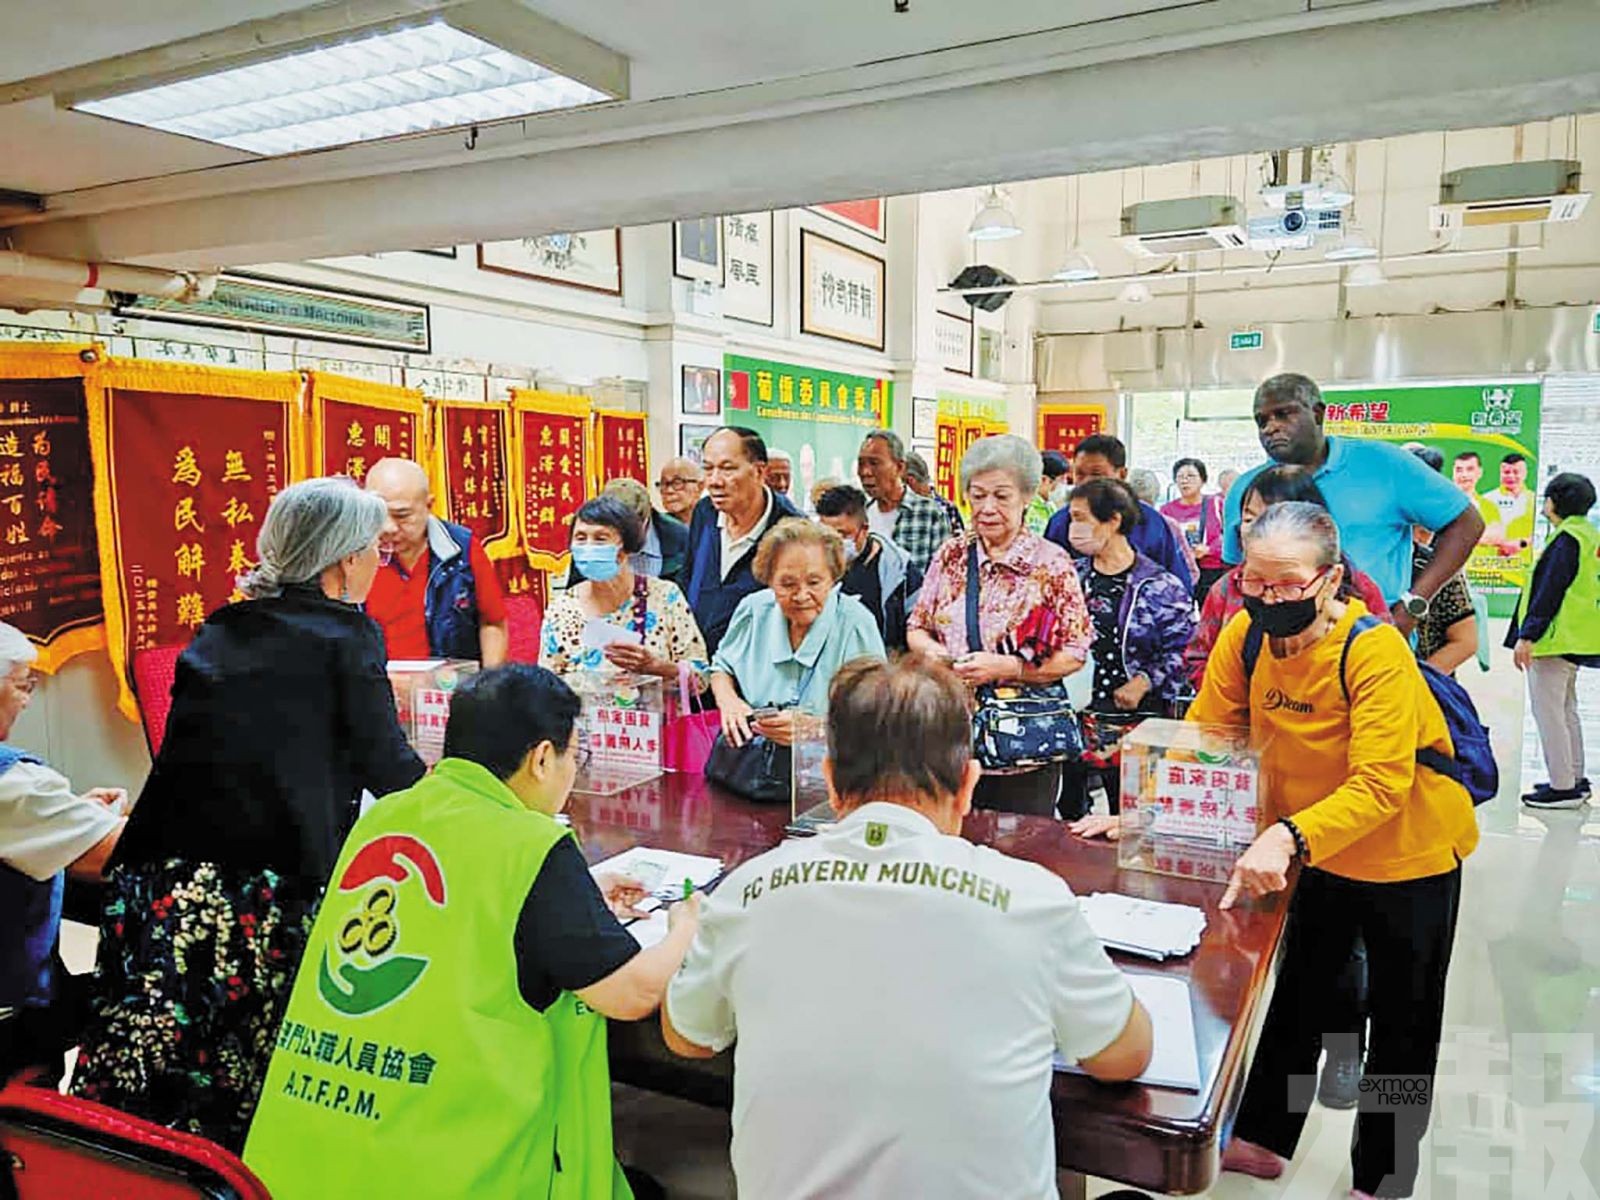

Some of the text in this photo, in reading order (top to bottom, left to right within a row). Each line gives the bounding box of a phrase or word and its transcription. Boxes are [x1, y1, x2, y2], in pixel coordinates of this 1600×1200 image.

[1326, 401, 1389, 421] 新希望
[742, 877, 763, 907] FC
[770, 860, 868, 890] BAYERN
[283, 1070, 381, 1120] A.T.F.P.M.
